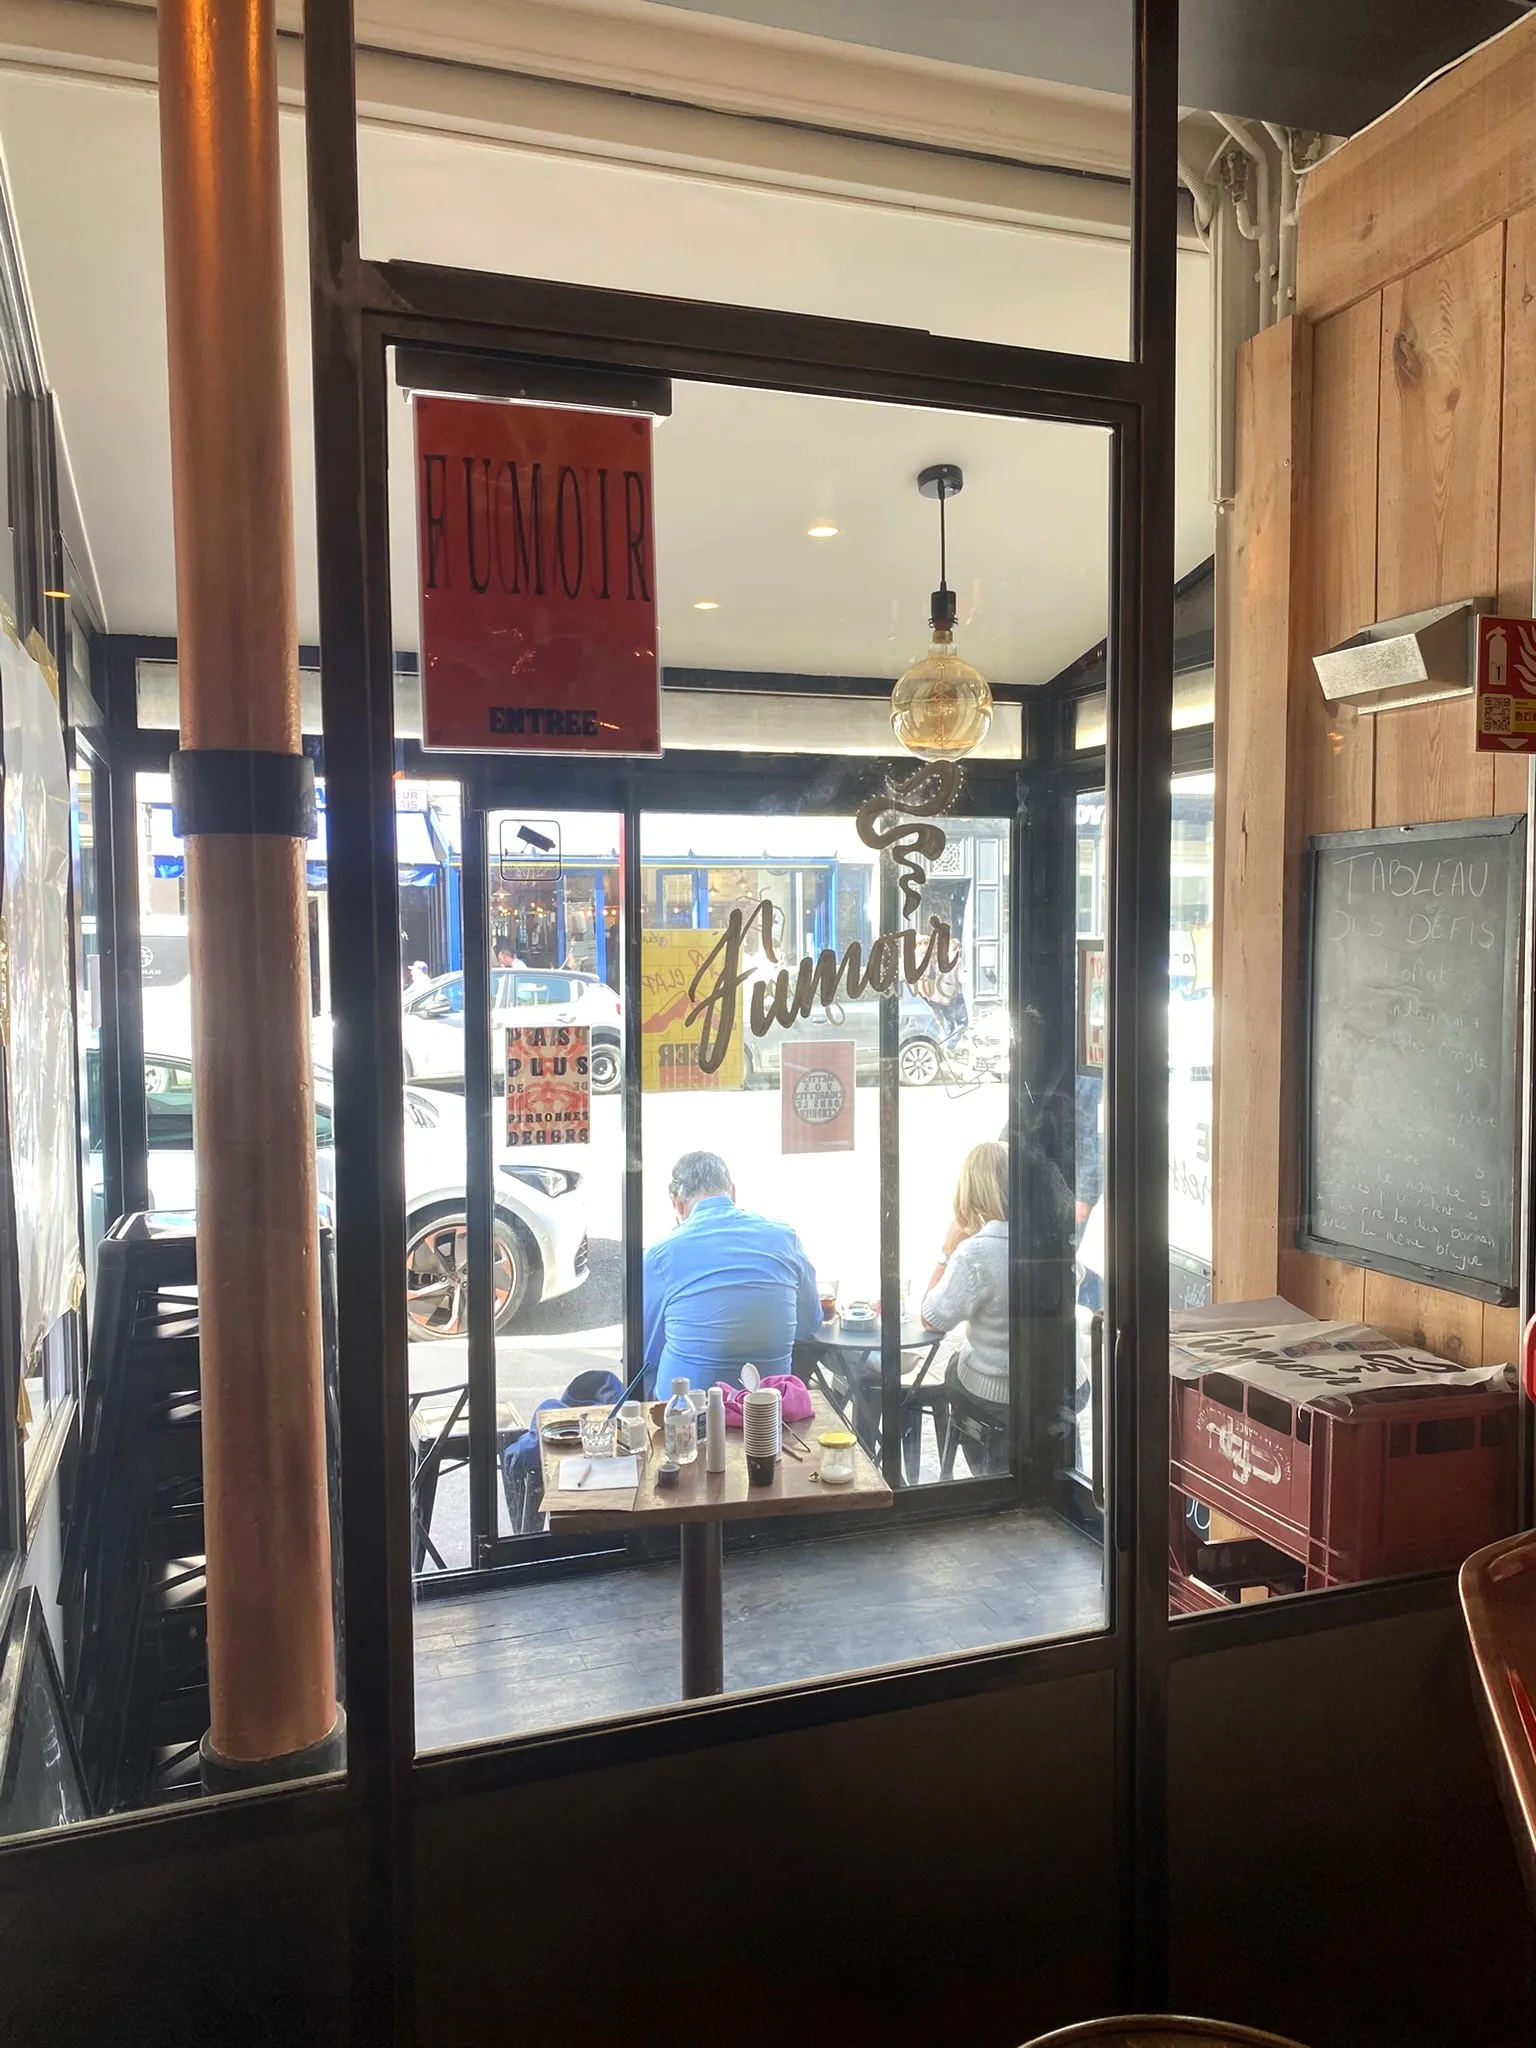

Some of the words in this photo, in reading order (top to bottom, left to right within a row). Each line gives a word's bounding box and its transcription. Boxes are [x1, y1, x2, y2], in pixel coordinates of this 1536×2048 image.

[423, 453, 651, 602] FUMOIR
[488, 706, 599, 737] ENTREE
[508, 1056, 589, 1077] PLUS
[508, 1128, 589, 1146] DEHORS
